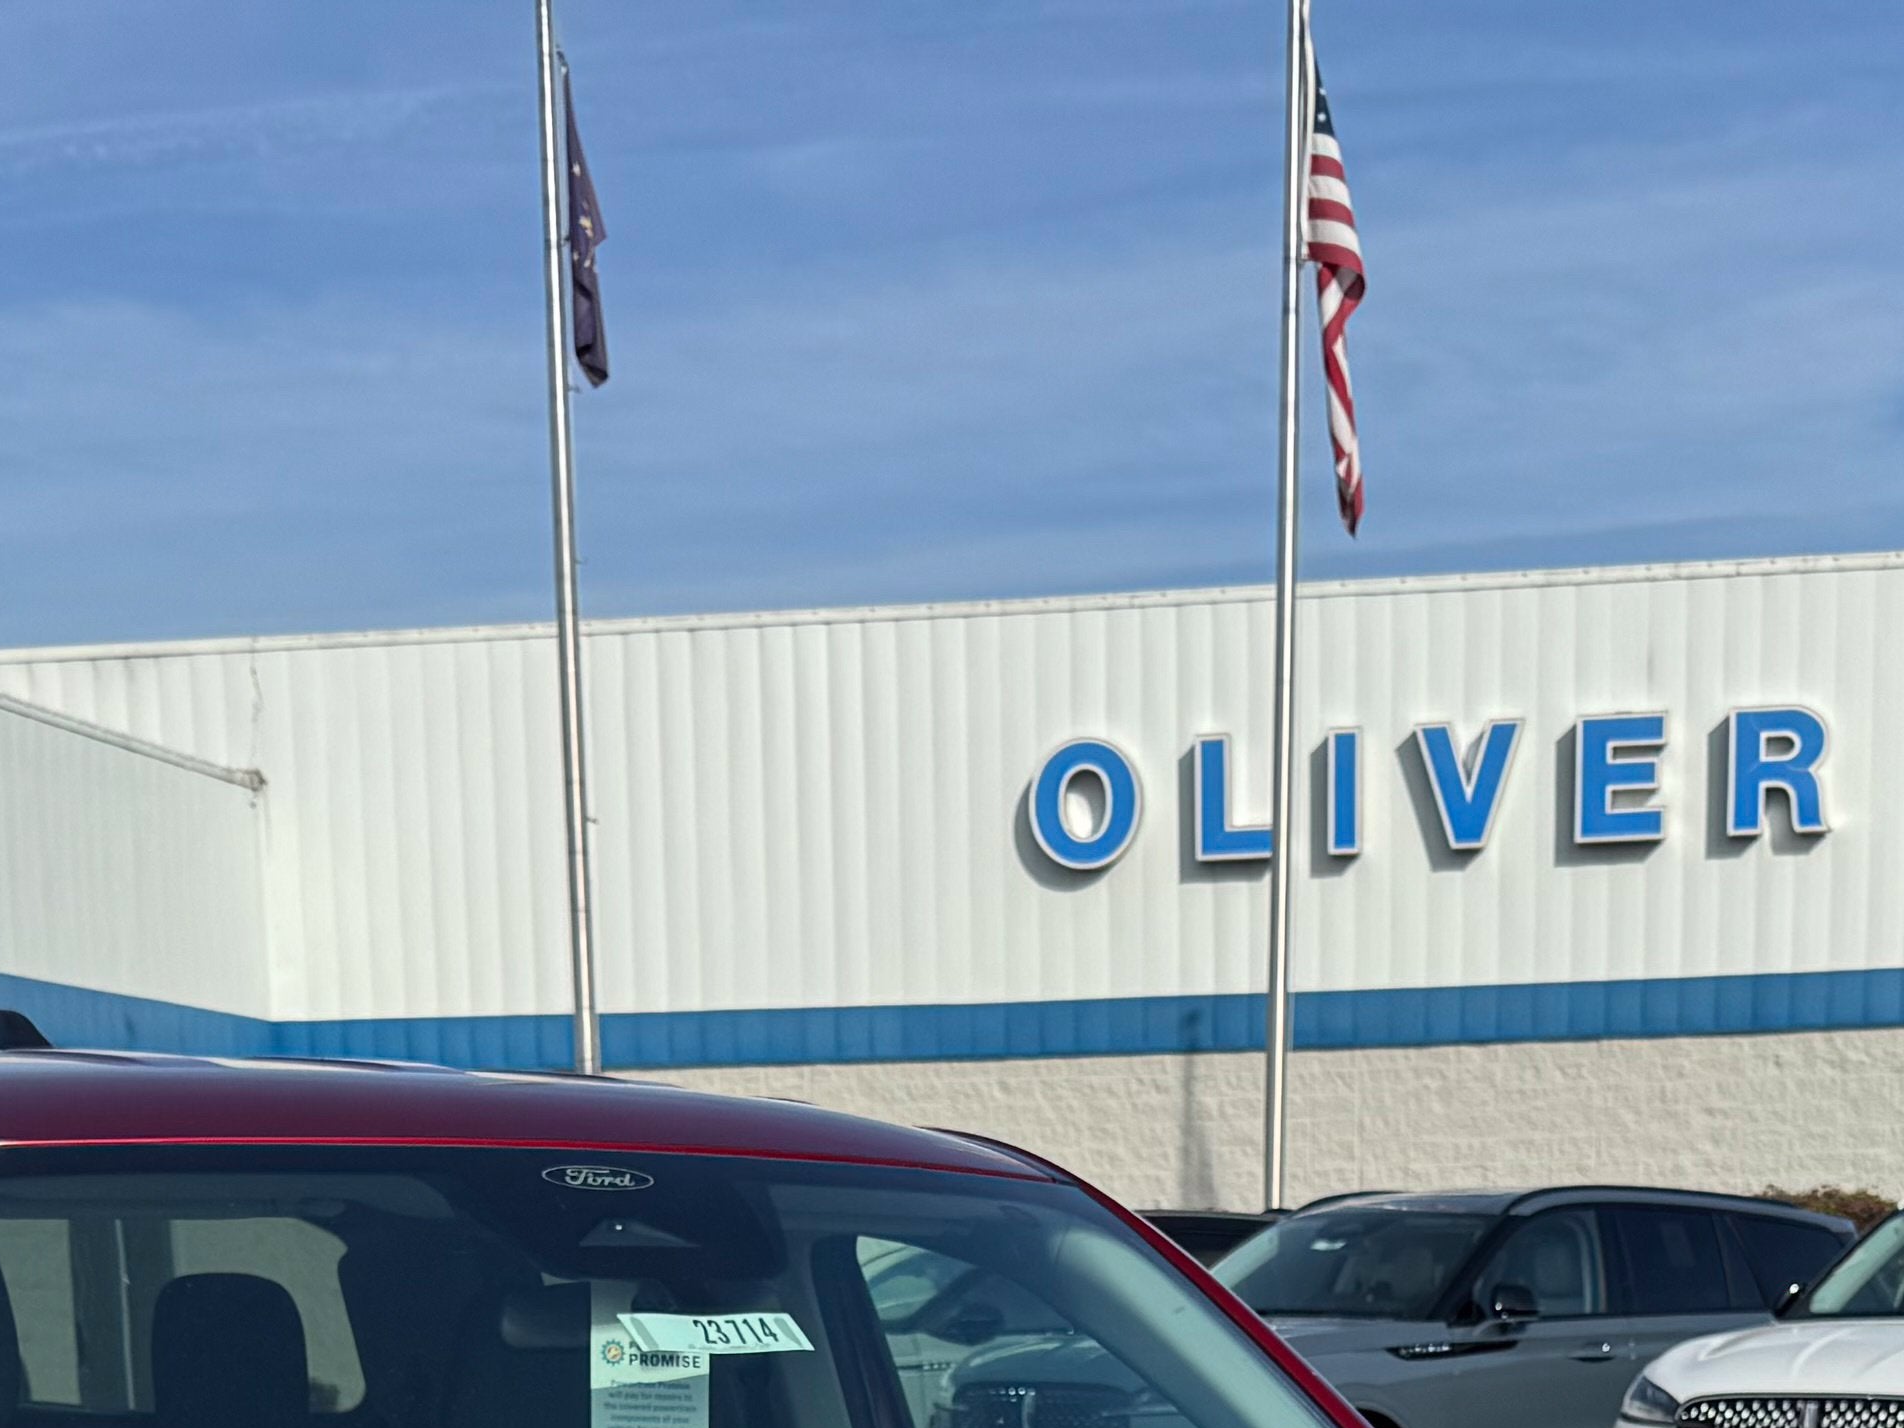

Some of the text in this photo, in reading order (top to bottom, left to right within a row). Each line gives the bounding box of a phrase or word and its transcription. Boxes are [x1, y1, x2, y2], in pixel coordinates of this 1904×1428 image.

[1028, 704, 1829, 871] OLIVER
[564, 1168, 635, 1186] Ford
[692, 1317, 780, 1345] 23714
[629, 1353, 701, 1369] PROMISE
